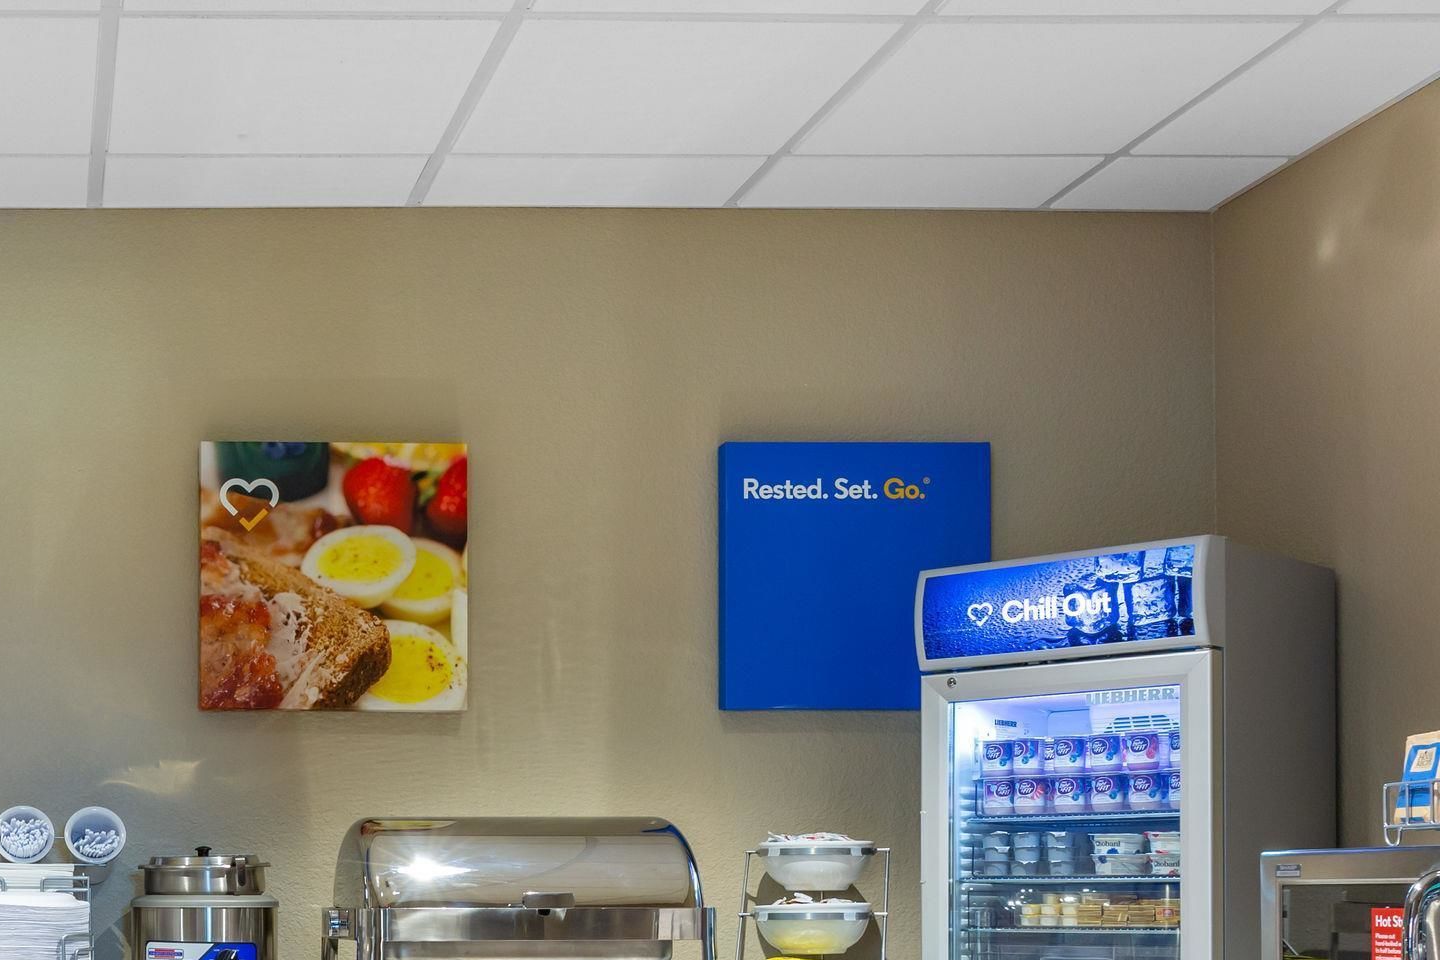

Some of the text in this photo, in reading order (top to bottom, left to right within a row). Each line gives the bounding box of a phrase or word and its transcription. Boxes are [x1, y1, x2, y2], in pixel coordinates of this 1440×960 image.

[743, 478, 829, 500] Rested.
[834, 478, 878, 500] Set.
[1002, 592, 1112, 624] Chill Out
[1085, 687, 1175, 705] LIEBHERR
[1375, 915, 1391, 927] Hot
